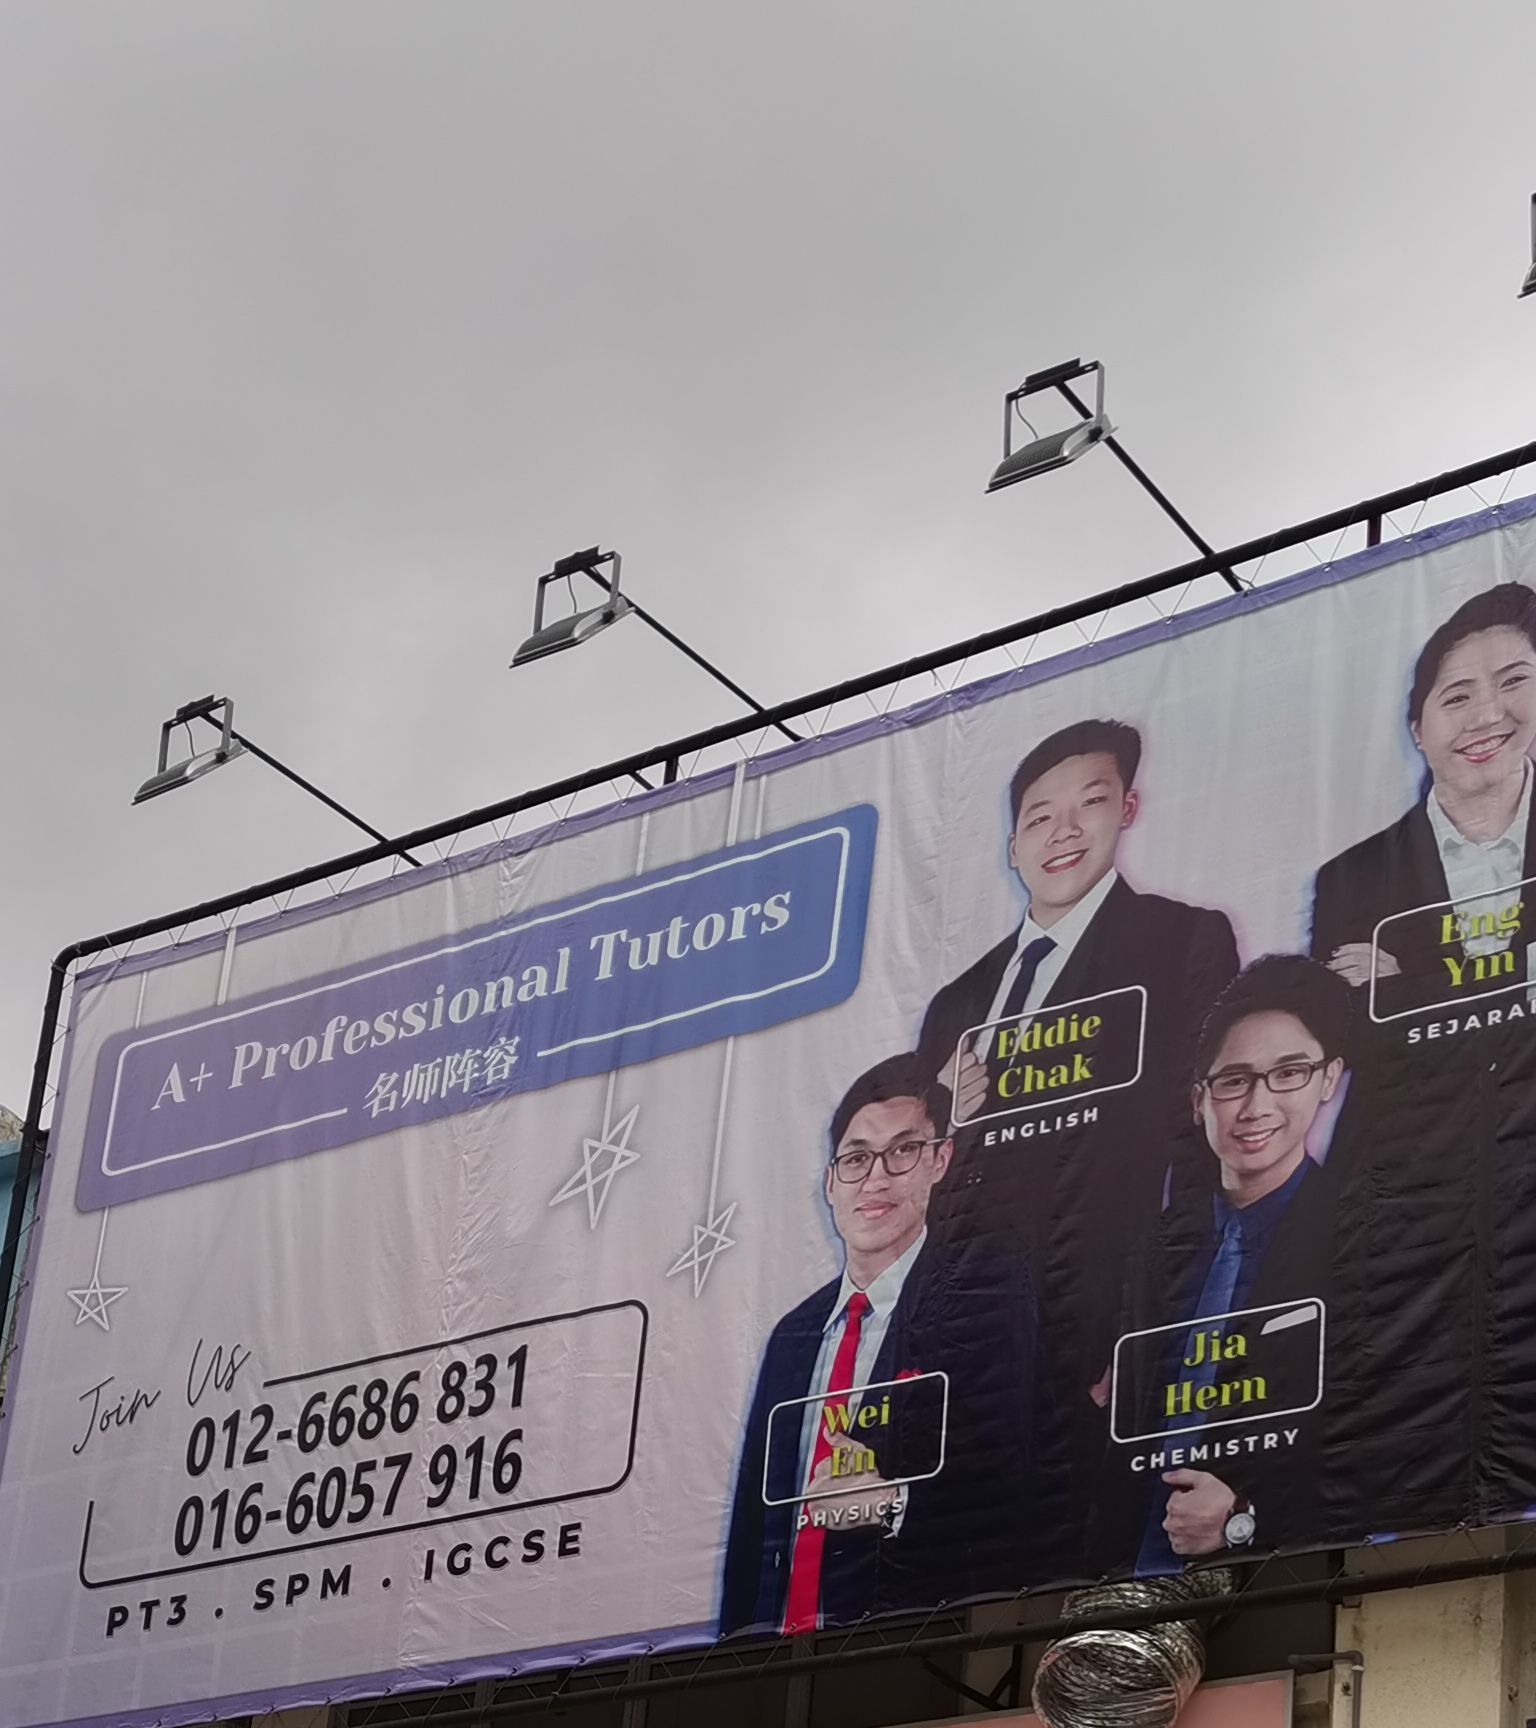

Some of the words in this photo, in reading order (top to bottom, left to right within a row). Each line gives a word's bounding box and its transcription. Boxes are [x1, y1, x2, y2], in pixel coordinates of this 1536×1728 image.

[1442, 951, 1517, 988] Yin
[150, 1061, 214, 1111] A+
[228, 948, 569, 1090] Professional
[590, 890, 793, 982] Tutors
[996, 1010, 1102, 1060] Eddie
[363, 1036, 523, 1119] 名师阵容
[997, 1053, 1095, 1100] Chak
[983, 1106, 1100, 1147] ENGLISH
[1182, 1330, 1248, 1368] Jia
[73, 1375, 162, 1455] Join
[186, 1338, 252, 1407] Us
[185, 1370, 421, 1478] 012-6686
[435, 1344, 529, 1425] 831
[822, 1395, 891, 1437] Wei
[1163, 1375, 1268, 1419] Hern
[1129, 1428, 1300, 1473] CHEMISTRY
[173, 1452, 412, 1558] 016-6057
[425, 1428, 524, 1508] 916
[795, 1498, 904, 1531] PHYSICS
[105, 1594, 189, 1639] PT3
[252, 1565, 352, 1612] SPM
[422, 1521, 584, 1583] IGCSE
